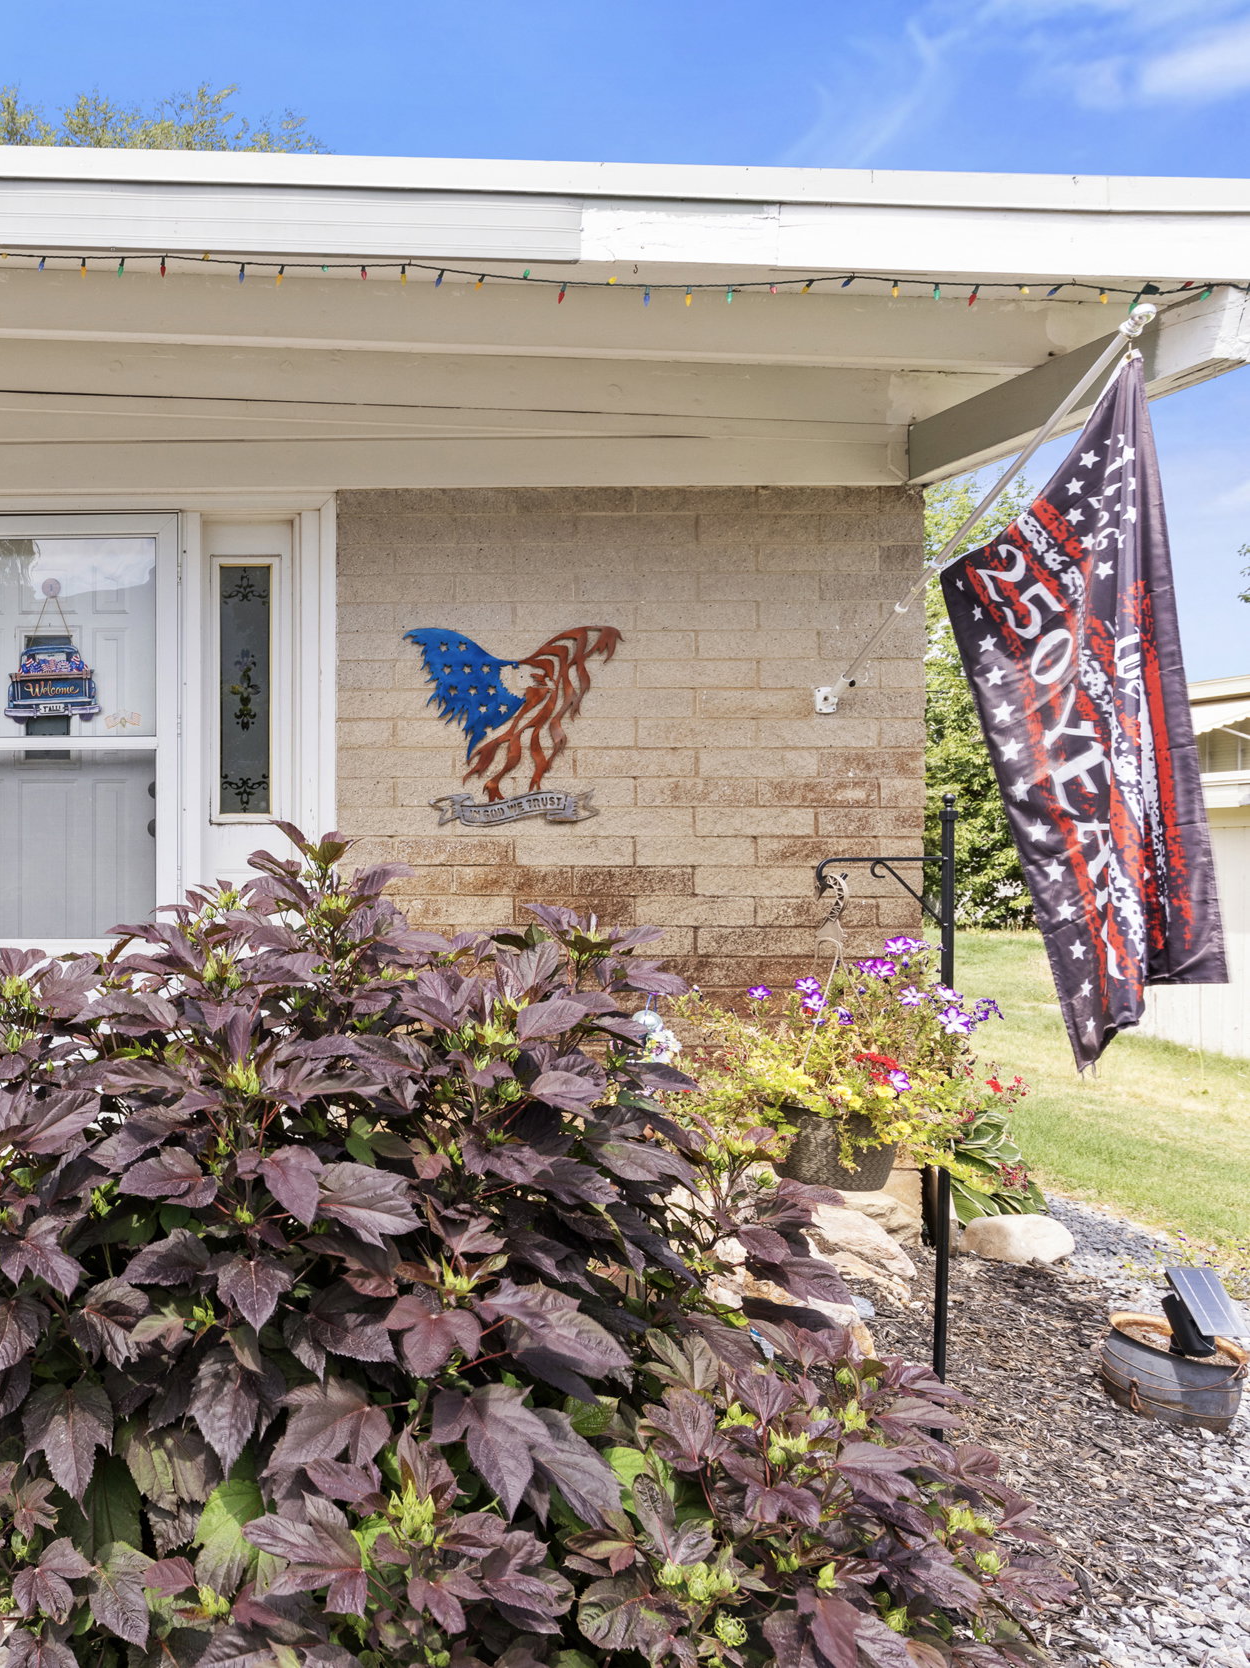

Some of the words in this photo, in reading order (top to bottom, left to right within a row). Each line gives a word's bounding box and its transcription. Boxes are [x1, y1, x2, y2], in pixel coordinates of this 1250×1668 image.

[975, 543, 1075, 686] 250
[24, 680, 80, 697] Welcome
[468, 808, 482, 820] IN
[484, 806, 505, 821] GOD
[506, 801, 525, 814] WE
[526, 795, 563, 810] TRUST
